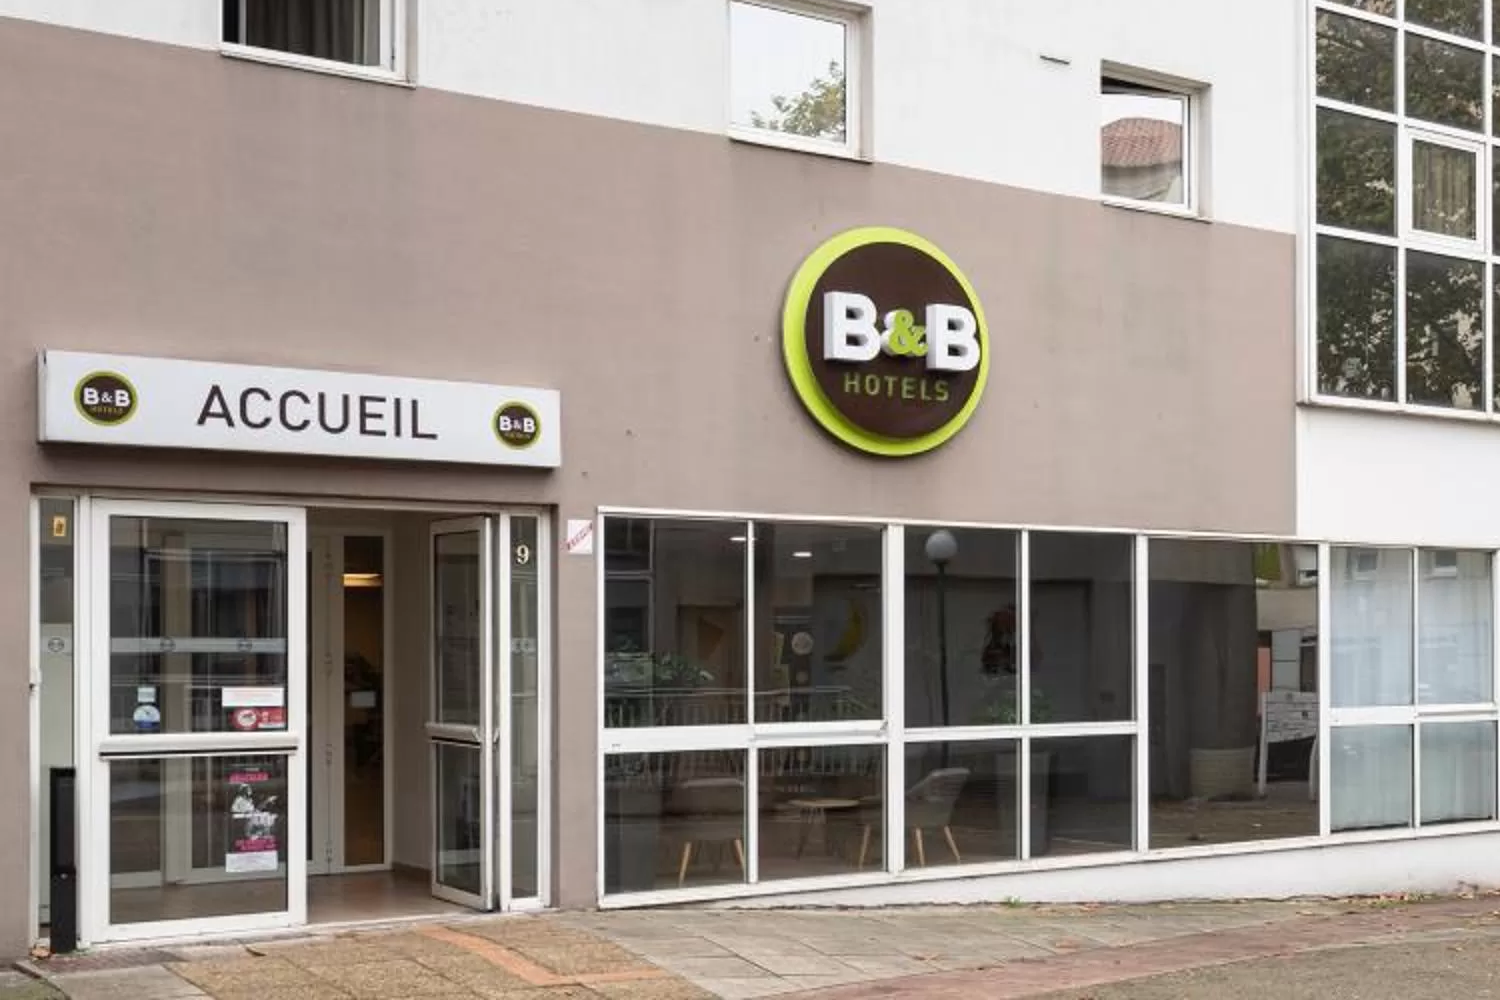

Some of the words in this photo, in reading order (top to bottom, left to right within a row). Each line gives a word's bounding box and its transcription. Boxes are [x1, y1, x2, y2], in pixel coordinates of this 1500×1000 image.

[824, 291, 981, 371] B&B
[83, 387, 131, 407] B&B
[843, 372, 949, 401] HOTELS
[196, 384, 438, 440] ACCUEIL
[500, 415, 536, 433] B&B
[516, 543, 530, 565] 9
